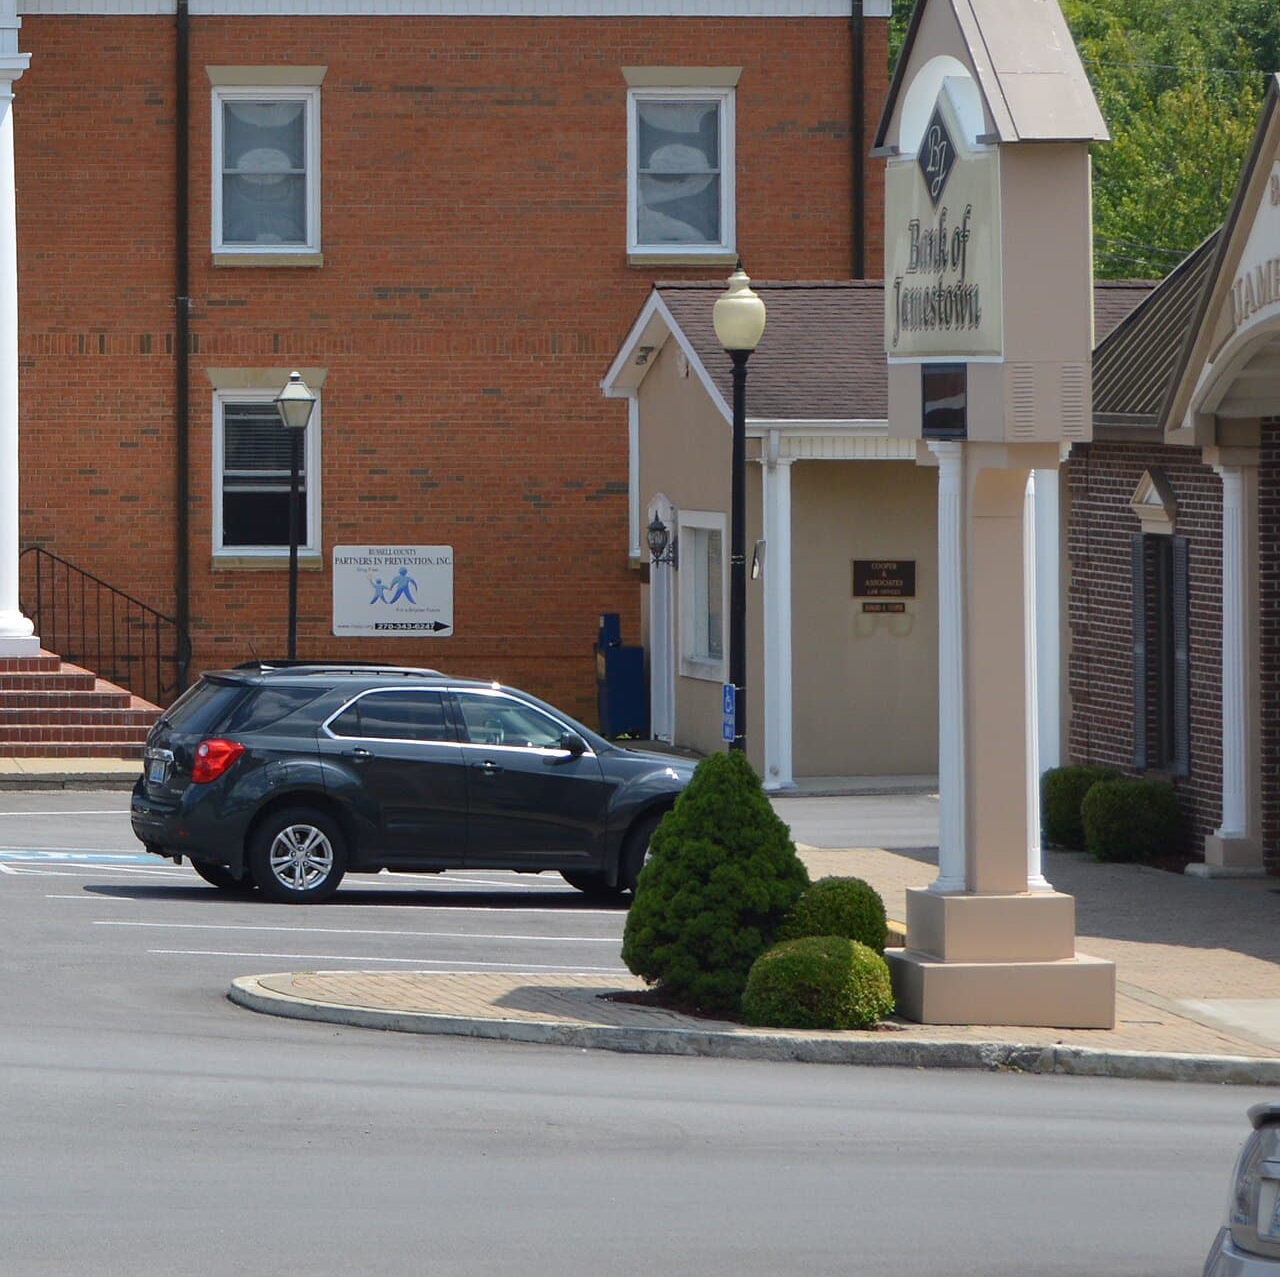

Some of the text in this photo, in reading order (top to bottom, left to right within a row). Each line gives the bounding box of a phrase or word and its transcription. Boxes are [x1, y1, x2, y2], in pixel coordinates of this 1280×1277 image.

[906, 204, 972, 280] Bank of
[893, 277, 981, 348] Jamestown
[335, 556, 372, 565] PARTNERS
[374, 556, 383, 565] IN
[369, 548, 416, 556] RUSSELL COUNTY
